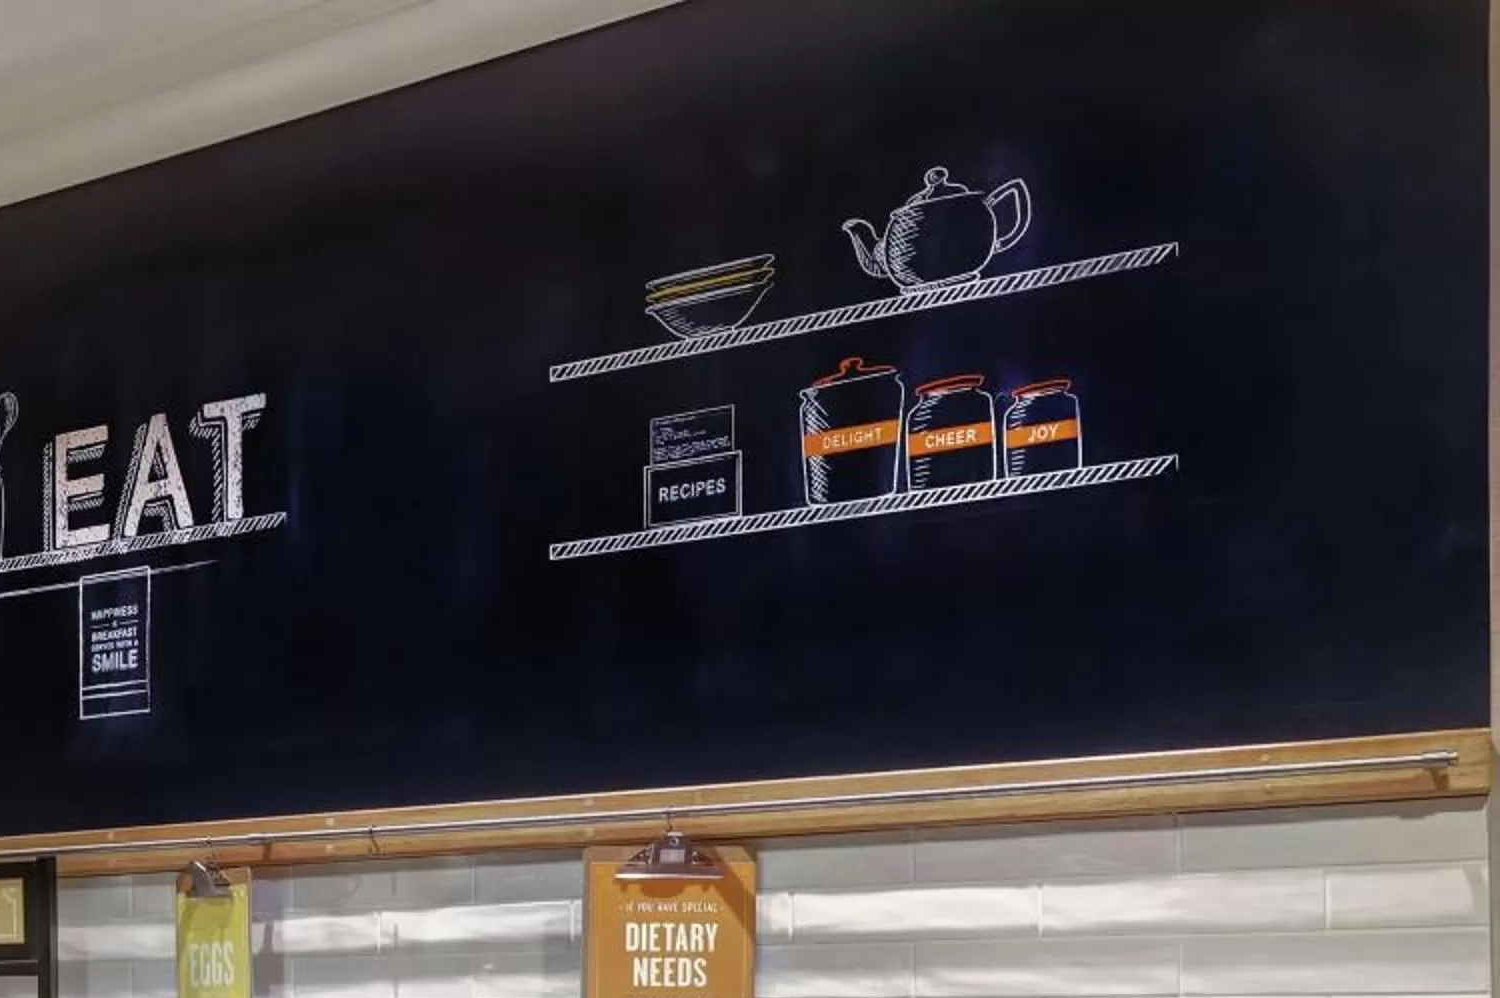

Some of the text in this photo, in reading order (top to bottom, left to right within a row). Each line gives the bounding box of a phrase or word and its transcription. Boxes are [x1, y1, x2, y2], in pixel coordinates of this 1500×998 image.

[823, 427, 882, 449] DELIGHT
[925, 429, 977, 449] CHEER
[1028, 424, 1059, 443] JOY
[44, 393, 267, 551] EAT
[659, 478, 726, 502] RECIPES
[91, 605, 139, 620] HAPPINESS
[91, 627, 137, 642] BREAKFAST
[91, 649, 139, 672] SMILE
[637, 902, 655, 912] YOU
[658, 902, 678, 912] HAVE
[681, 901, 718, 913] SPECIAL
[625, 922, 718, 952] DIETARY
[190, 941, 235, 988] EGGS
[633, 957, 707, 987] NEEDS
